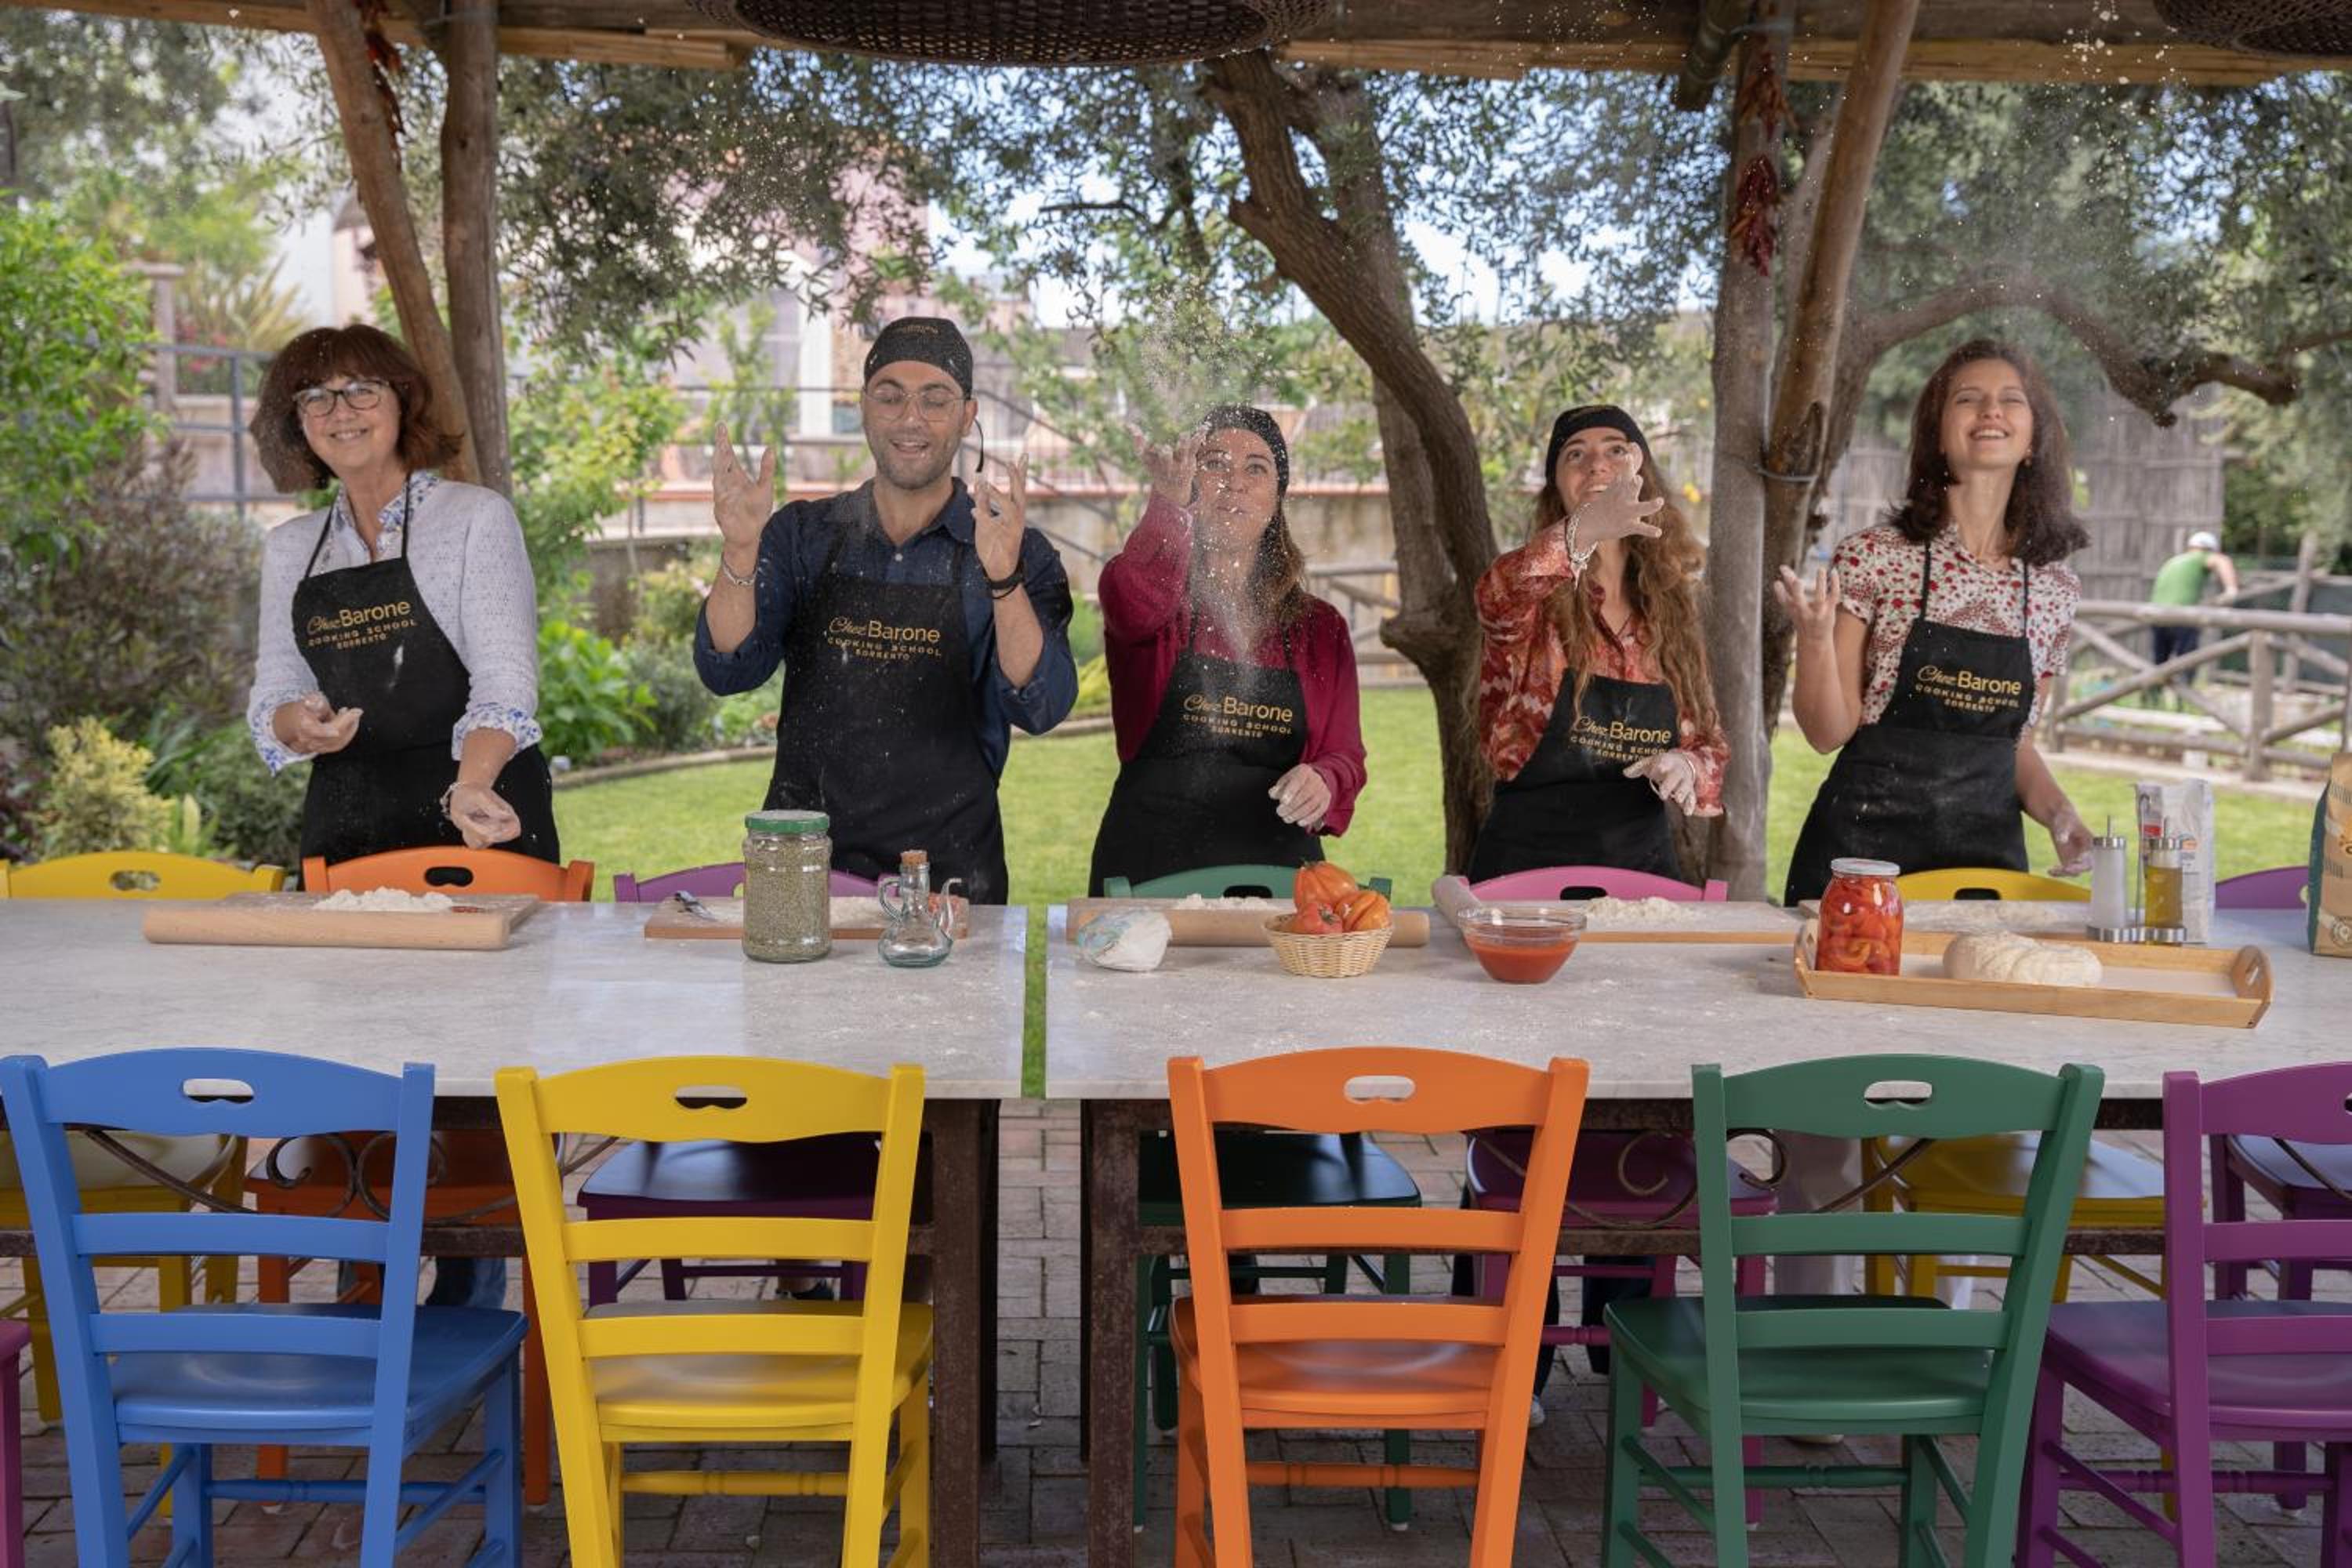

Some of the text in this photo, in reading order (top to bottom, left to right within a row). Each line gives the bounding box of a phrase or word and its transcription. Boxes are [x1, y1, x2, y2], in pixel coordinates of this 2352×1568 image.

[339, 601, 412, 626] Barone
[308, 619, 418, 647] COOKING SCHOOL
[868, 619, 941, 643] Barone
[827, 637, 942, 656] COOKING SCHOOL
[1915, 684, 1972, 702] COOKING
[1958, 670, 2022, 696] Barone
[1223, 695, 1293, 722] Barone
[1182, 714, 1292, 735] COOKING SCHOOL
[1610, 720, 1671, 744] Barone
[1570, 735, 1623, 752] COOKING
